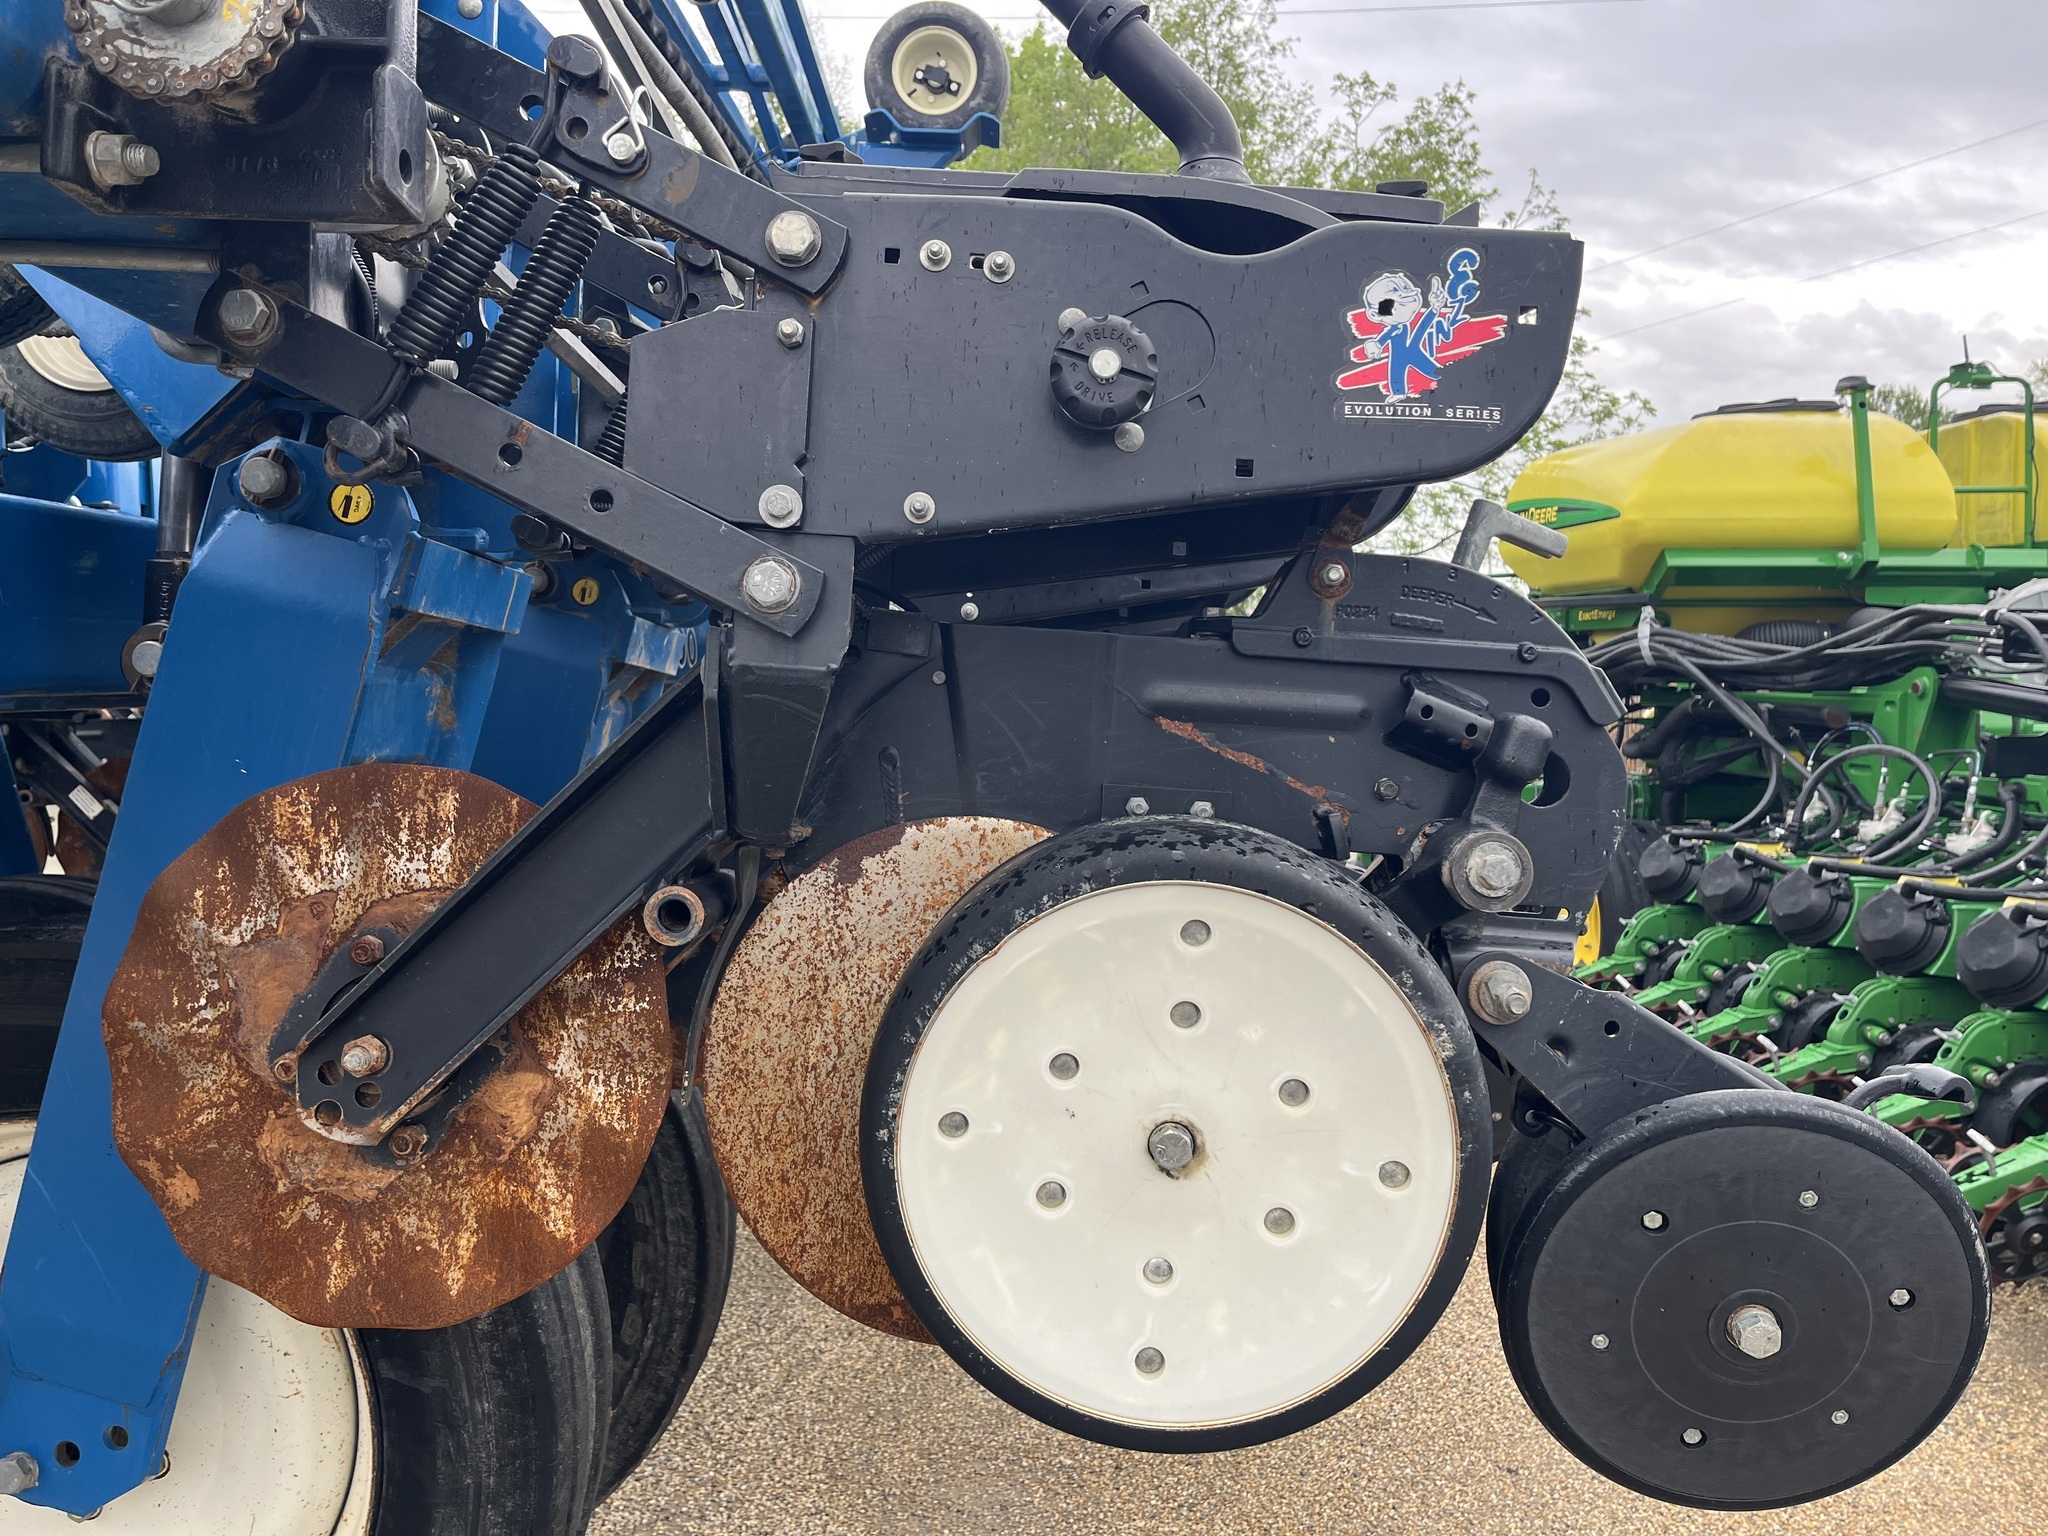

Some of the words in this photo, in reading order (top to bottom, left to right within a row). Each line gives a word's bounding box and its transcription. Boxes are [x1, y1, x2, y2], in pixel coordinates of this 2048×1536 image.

[1085, 328, 1138, 354] RELEASE
[1074, 381, 1115, 403] DRIVE
[1344, 404, 1432, 417] EVOLUTION
[1445, 408, 1501, 420] SERIES
[1402, 559, 1410, 574] 1
[1400, 584, 1456, 608] DEEPER
[1578, 608, 1616, 621] ExactEnergy
